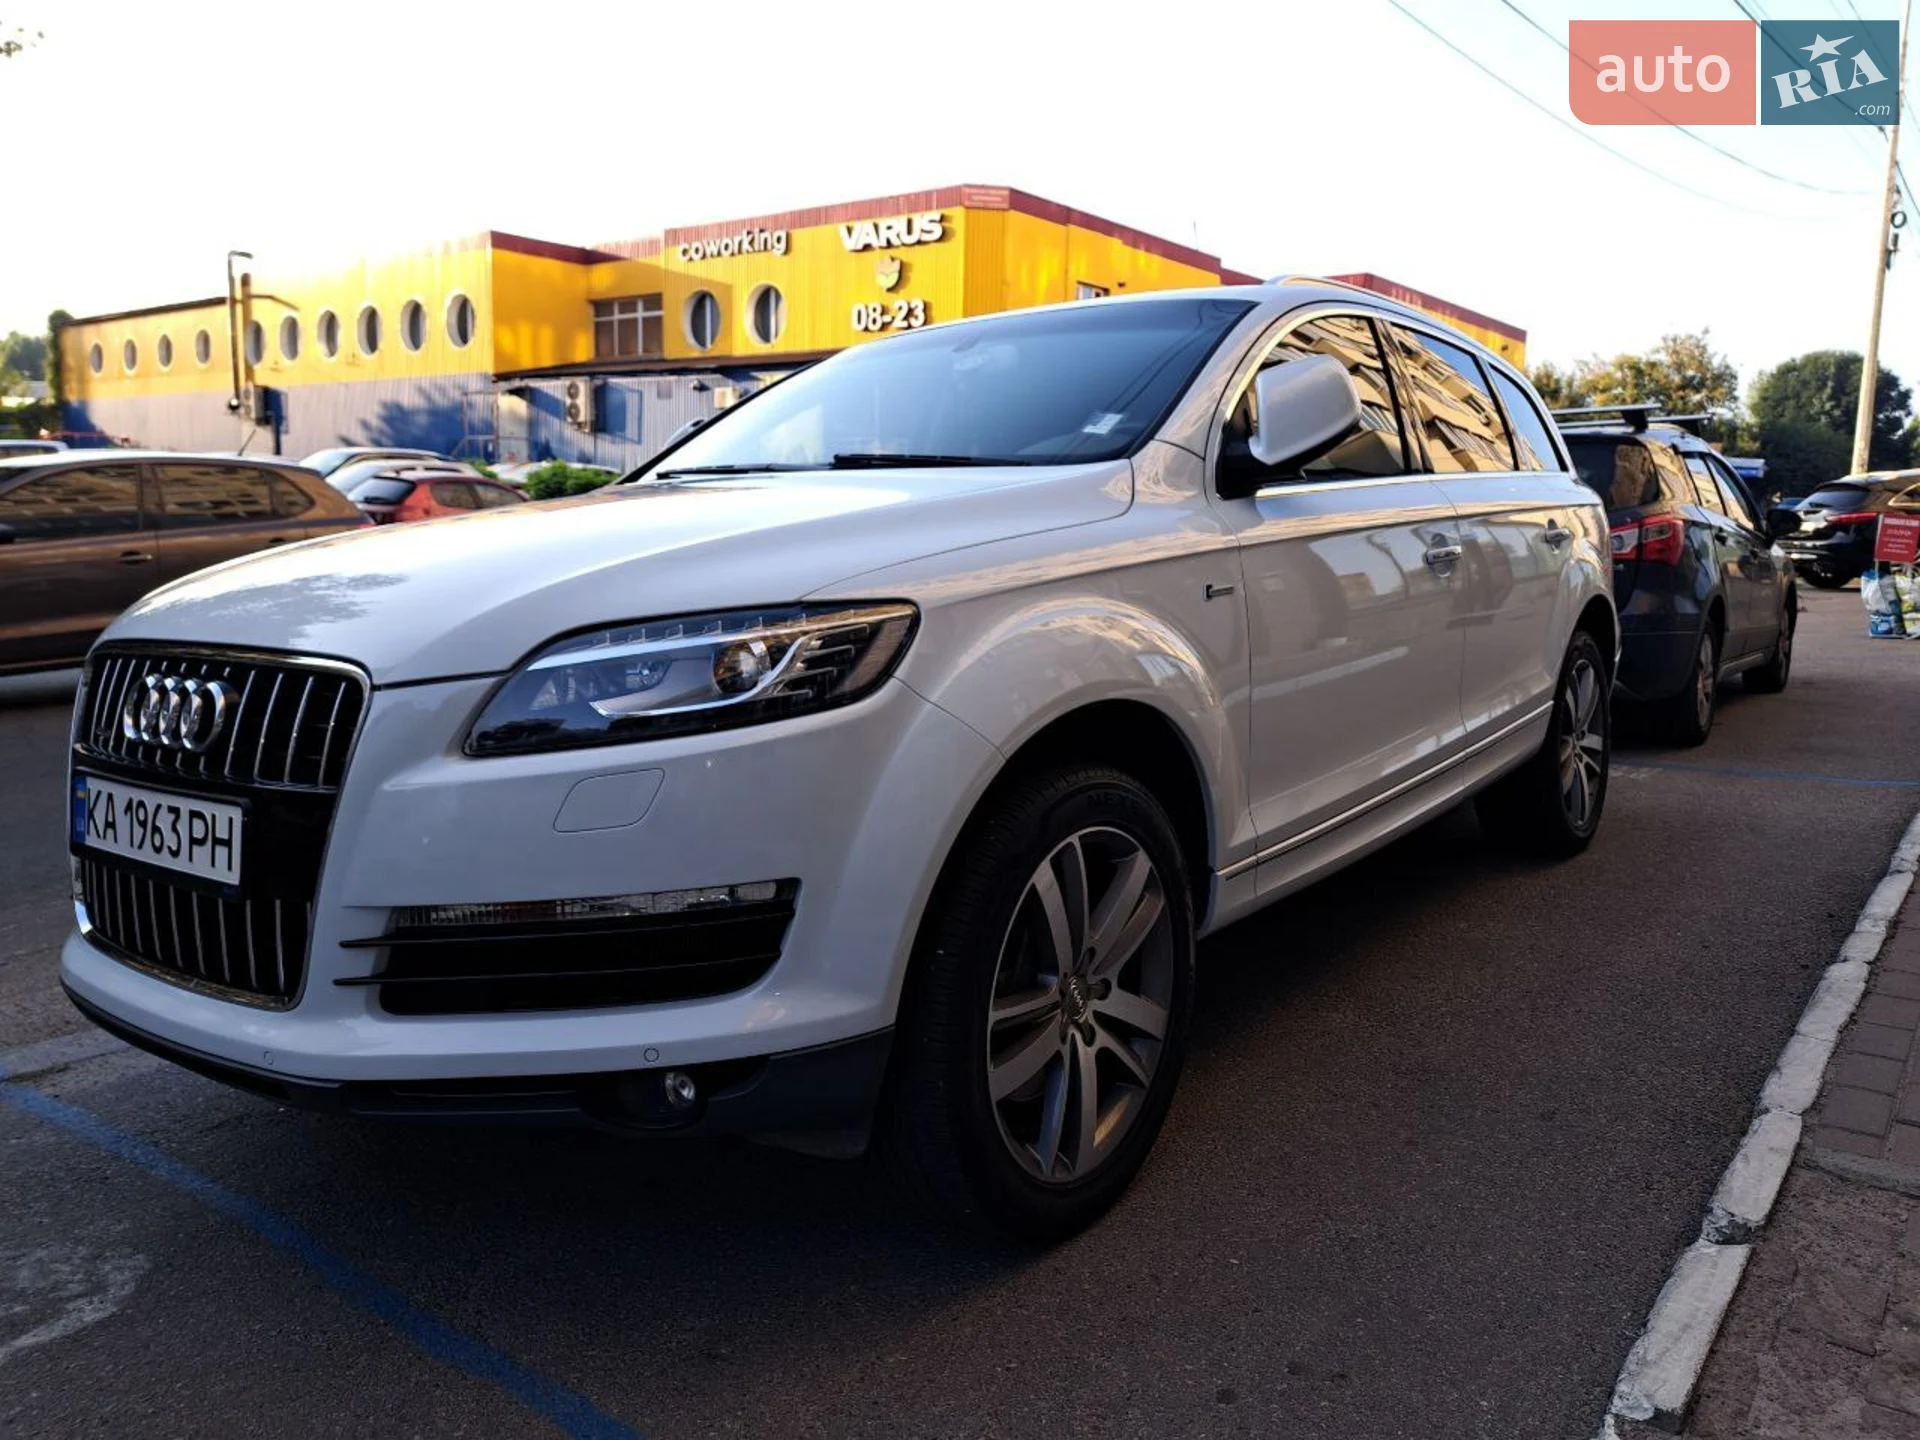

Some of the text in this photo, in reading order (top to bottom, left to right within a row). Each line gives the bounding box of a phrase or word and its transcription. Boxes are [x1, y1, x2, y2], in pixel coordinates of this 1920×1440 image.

[679, 229, 787, 262] coworking
[839, 213, 943, 251] VARUS
[853, 299, 926, 331] 08-23
[86, 788, 233, 872] KA 1963 PH
